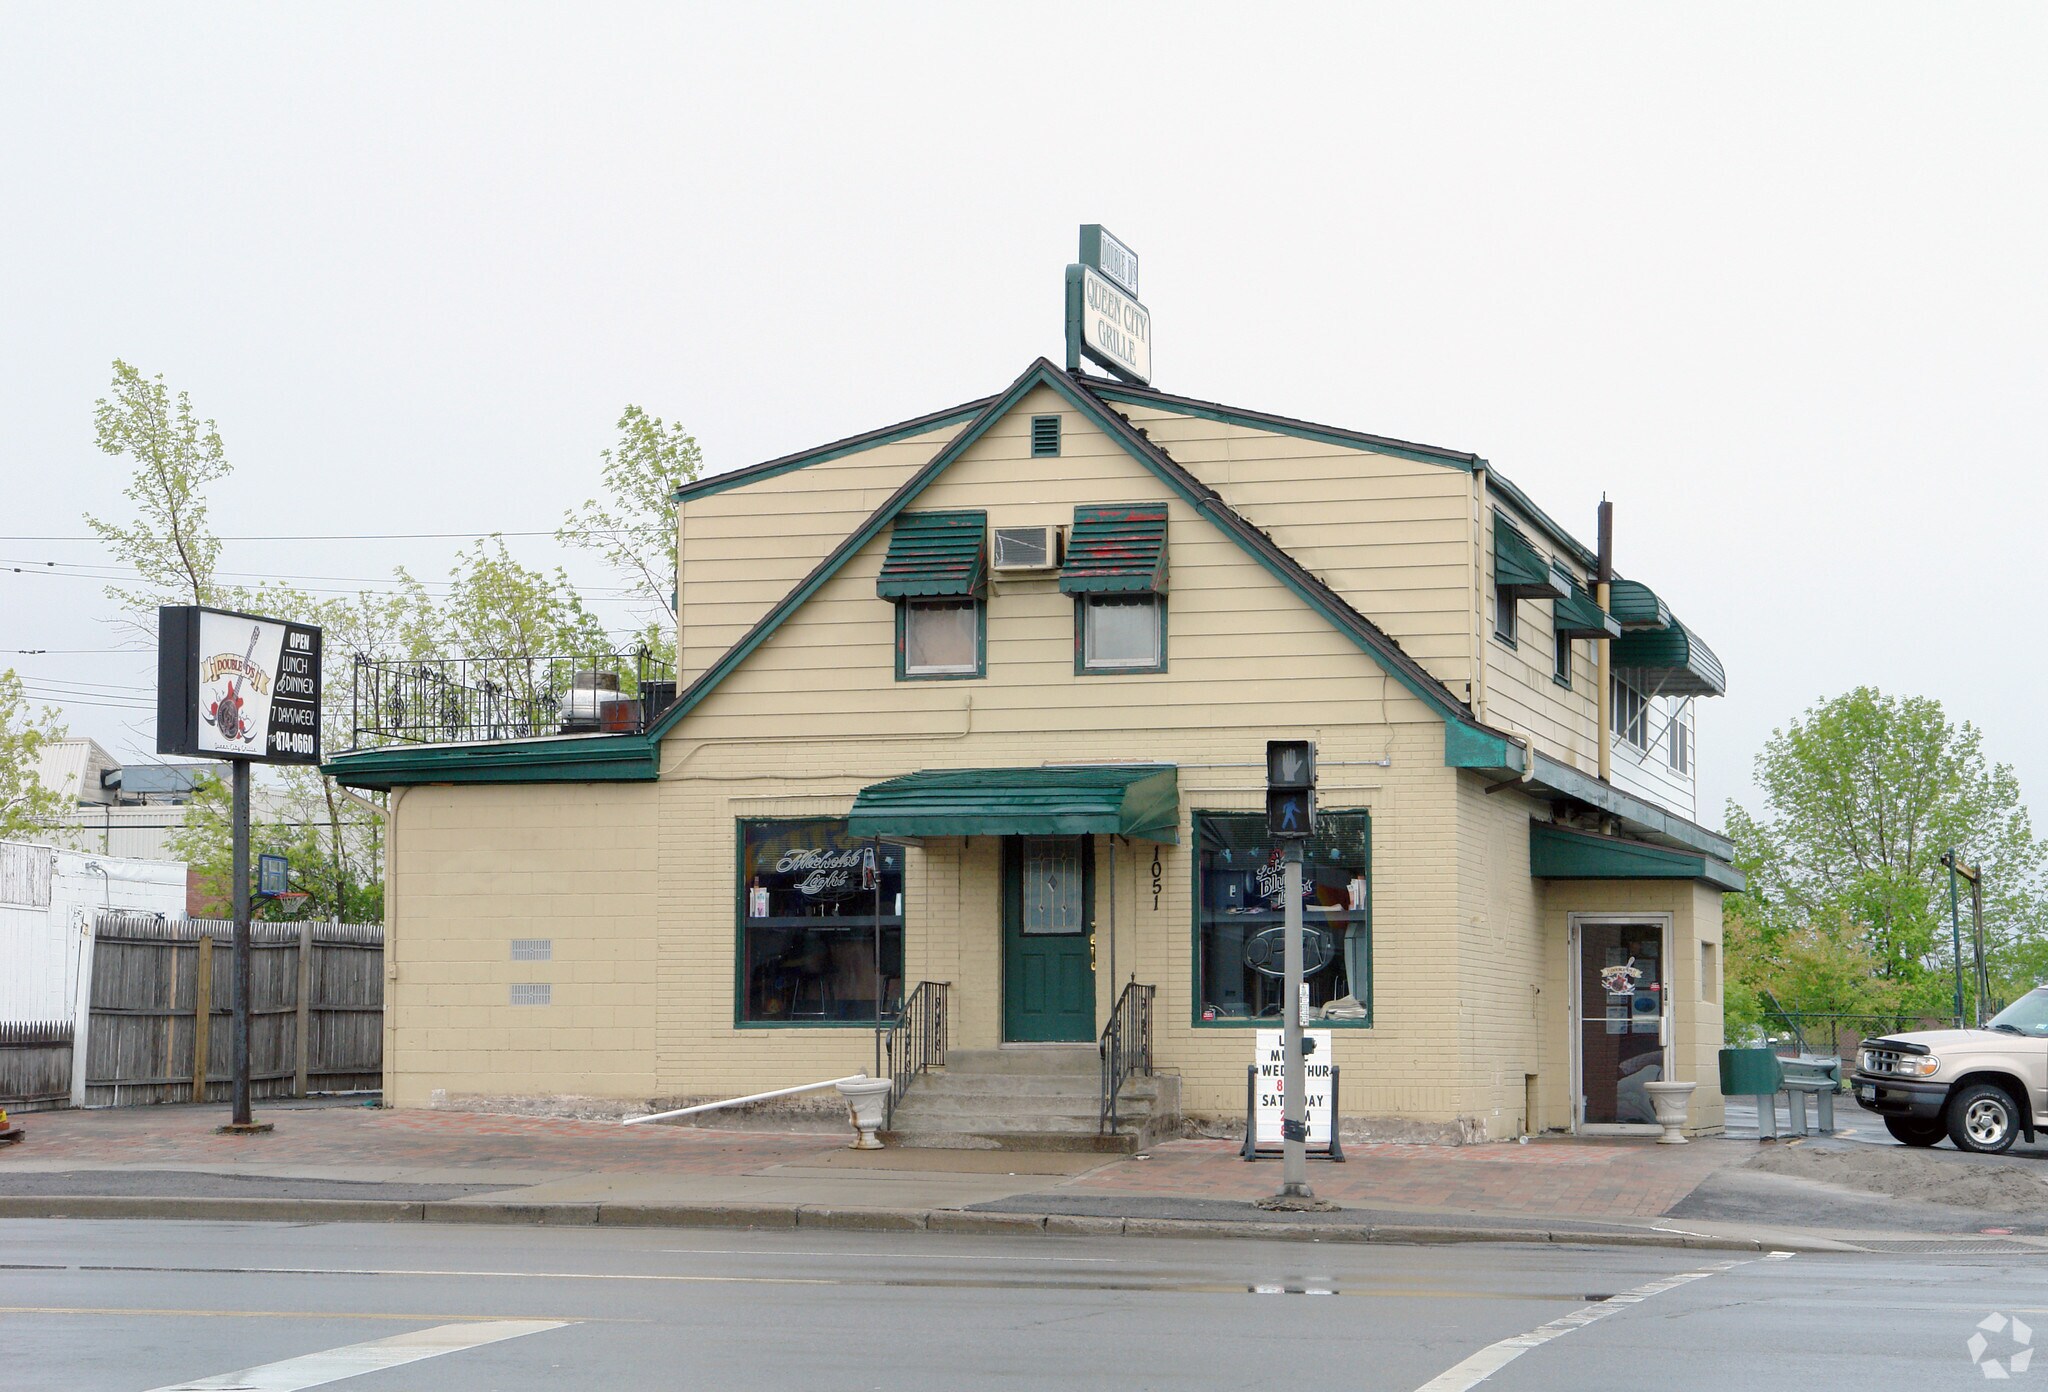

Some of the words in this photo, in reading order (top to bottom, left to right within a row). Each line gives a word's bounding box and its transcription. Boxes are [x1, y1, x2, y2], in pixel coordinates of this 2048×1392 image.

[1086, 277, 1121, 326] QUEEN
[1123, 302, 1147, 342] CITY
[1098, 319, 1137, 366] GRILLE
[290, 632, 310, 650] OPEN
[217, 658, 243, 671] DOUBLE
[282, 656, 308, 673] LUNCH
[271, 705, 276, 722] 7
[275, 731, 314, 754] 874-0660
[775, 848, 864, 873] Michelob
[793, 869, 849, 895] Light
[1151, 845, 1162, 911] 1051
